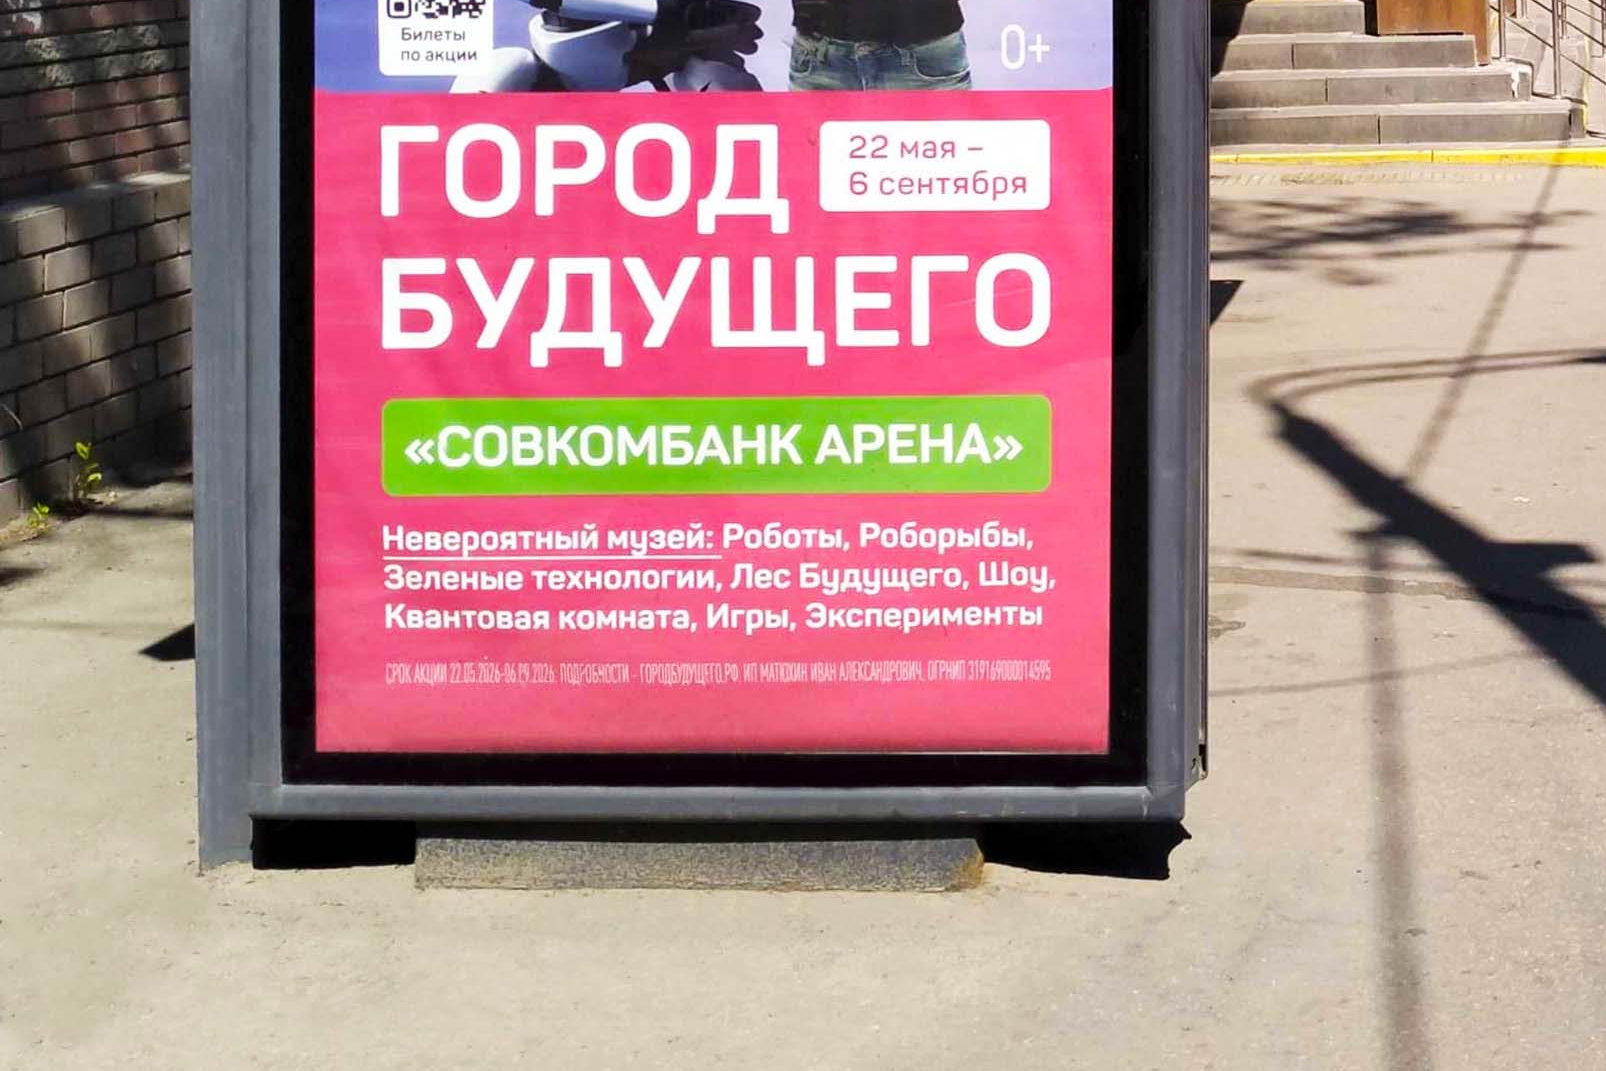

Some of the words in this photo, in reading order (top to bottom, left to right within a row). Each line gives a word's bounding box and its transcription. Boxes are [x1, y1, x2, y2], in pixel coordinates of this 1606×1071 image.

[400, 26, 466, 41] Билеты
[1001, 24, 1051, 70] 0+
[400, 49, 421, 62] по
[425, 49, 478, 63] акции
[849, 135, 889, 159] 22
[900, 141, 956, 159] мая
[380, 123, 790, 235] ГОРОД
[849, 171, 868, 195] 6
[879, 170, 1028, 202] сентября
[381, 252, 1053, 368] БУДУЩЕГО
[404, 423, 802, 468] «СОВКОМБАНК
[815, 423, 1024, 465] АРЕНА»
[382, 524, 599, 557] Невероятный
[607, 523, 714, 556] музей:
[722, 522, 850, 551] Роботы,
[859, 521, 1034, 555] Роборыбы,
[383, 563, 524, 591] Зеленые
[531, 567, 722, 594] технологии,
[730, 563, 791, 590] Лес
[799, 562, 969, 595] Будущего,
[978, 560, 1056, 593] Шоу,
[384, 602, 550, 630] Квантовая
[559, 608, 698, 633] комната,
[706, 602, 796, 635] Игры,
[805, 602, 1043, 634] Эксперименты
[385, 662, 412, 685] СРОК
[414, 662, 447, 686] АКЦИИ
[811, 661, 836, 682] ИВАН
